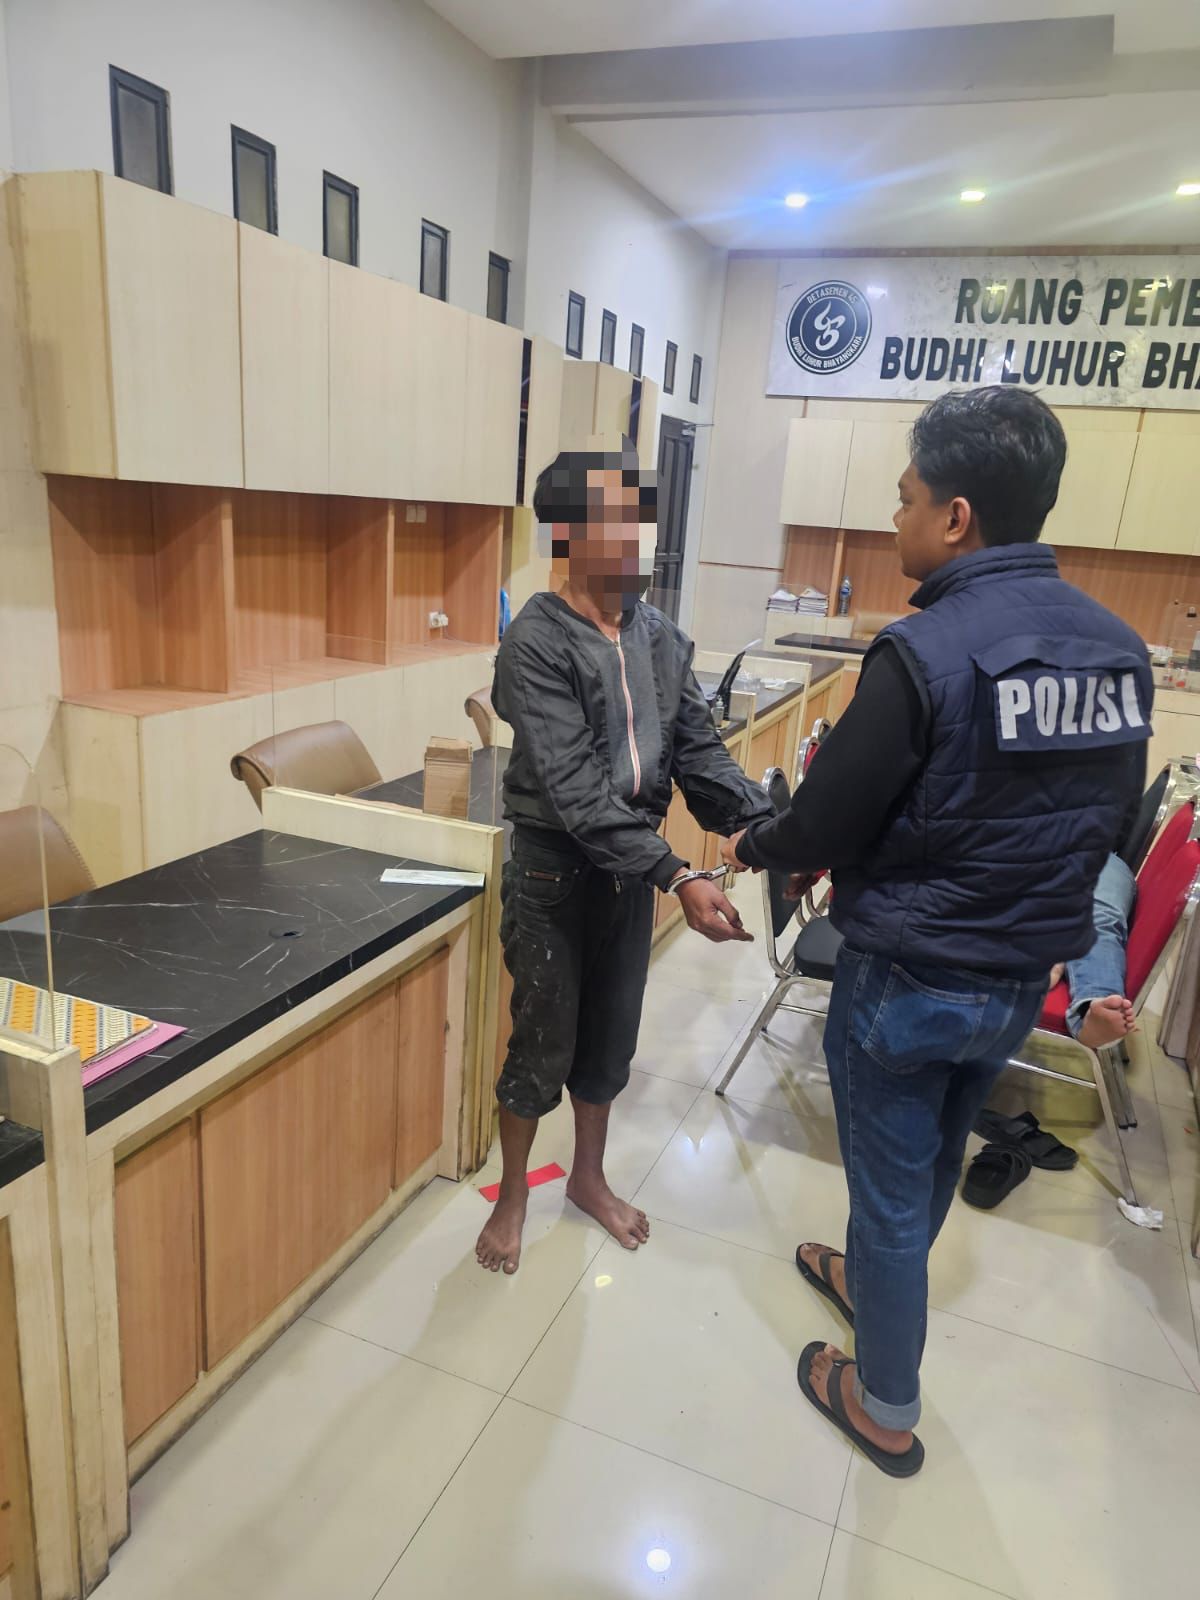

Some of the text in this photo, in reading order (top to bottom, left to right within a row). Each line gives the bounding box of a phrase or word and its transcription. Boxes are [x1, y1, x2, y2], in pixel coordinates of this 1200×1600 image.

[954, 278, 1084, 326] RUANG
[880, 336, 1200, 389] BUDHI LUHUR BH
[997, 672, 1144, 739] POLISI
